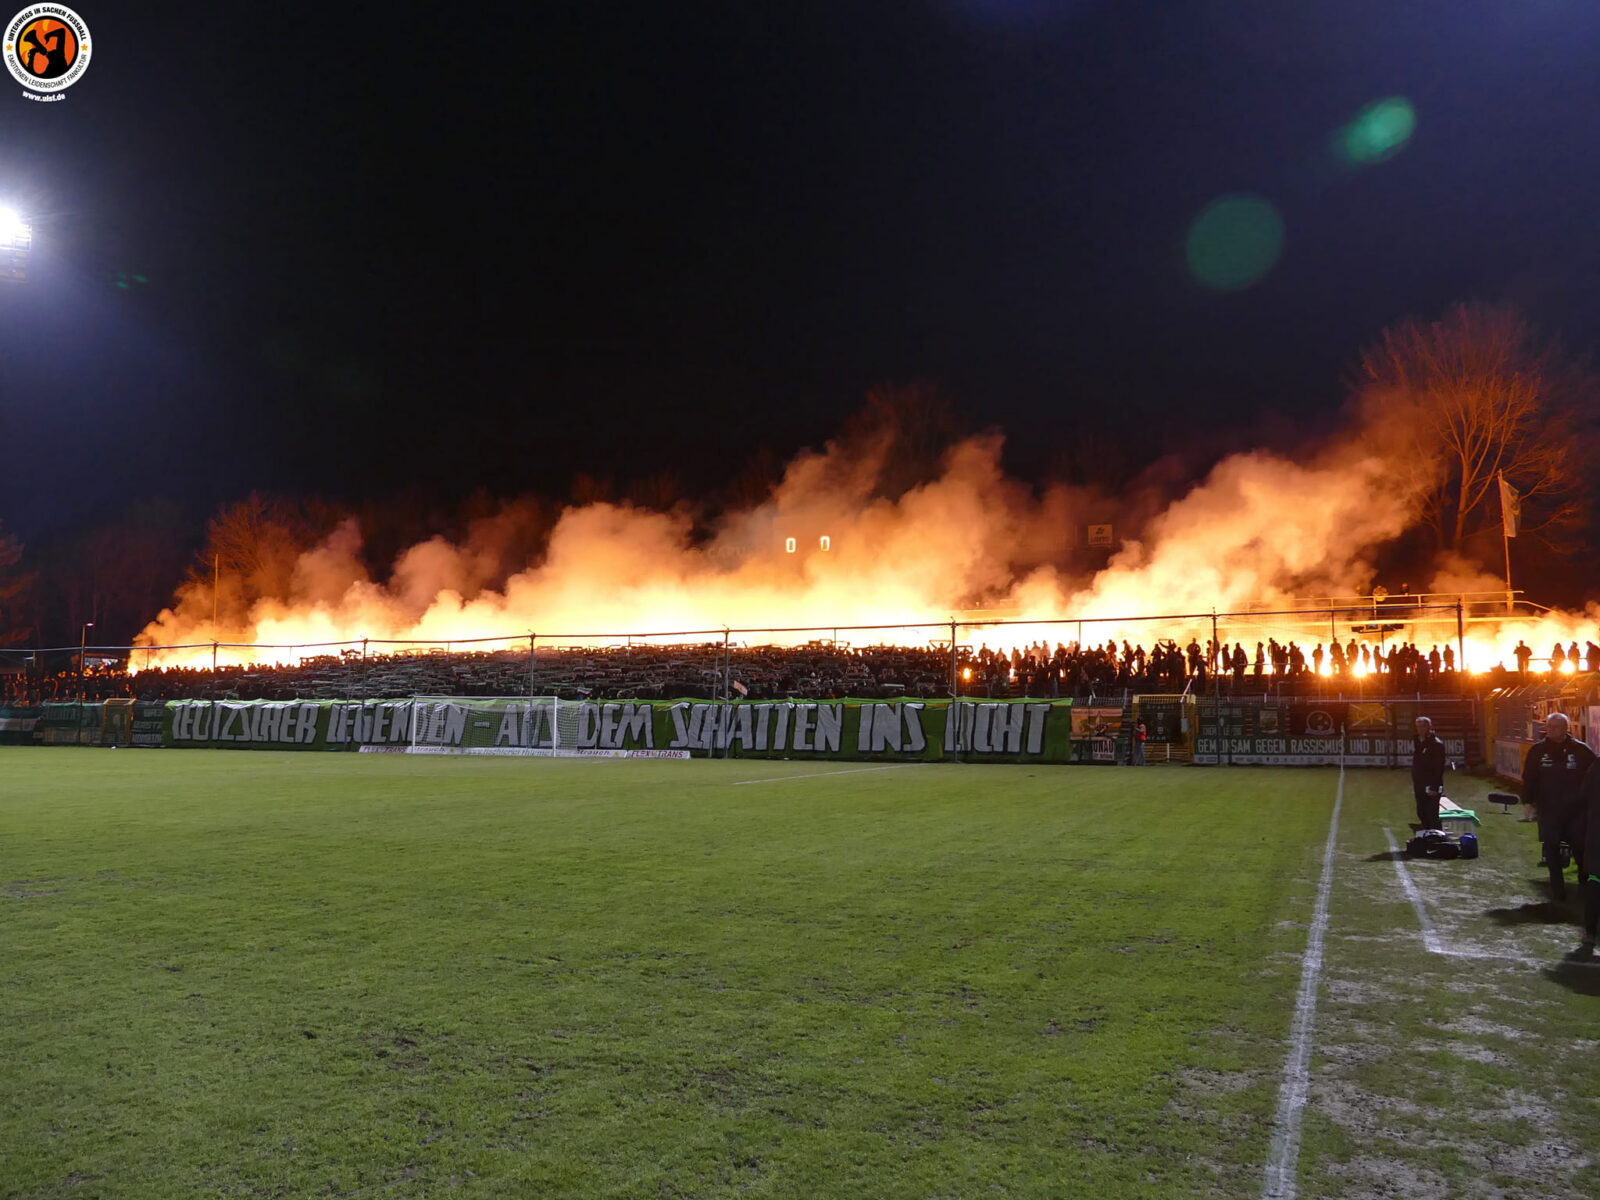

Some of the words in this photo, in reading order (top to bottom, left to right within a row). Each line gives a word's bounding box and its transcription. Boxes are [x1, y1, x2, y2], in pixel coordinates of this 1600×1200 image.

[172, 702, 319, 744] LEUTZSCHER
[326, 702, 471, 745] LEGENDEN
[577, 702, 654, 748] DEM
[669, 702, 844, 752] SCHATTEN
[858, 702, 927, 753] INS
[944, 702, 1053, 754] LICHT
[1255, 739, 1286, 753] GEGEN
[1290, 739, 1345, 754] RASSISMUS
[1350, 739, 1370, 754] UND
[656, 750, 684, 759] TRANS
